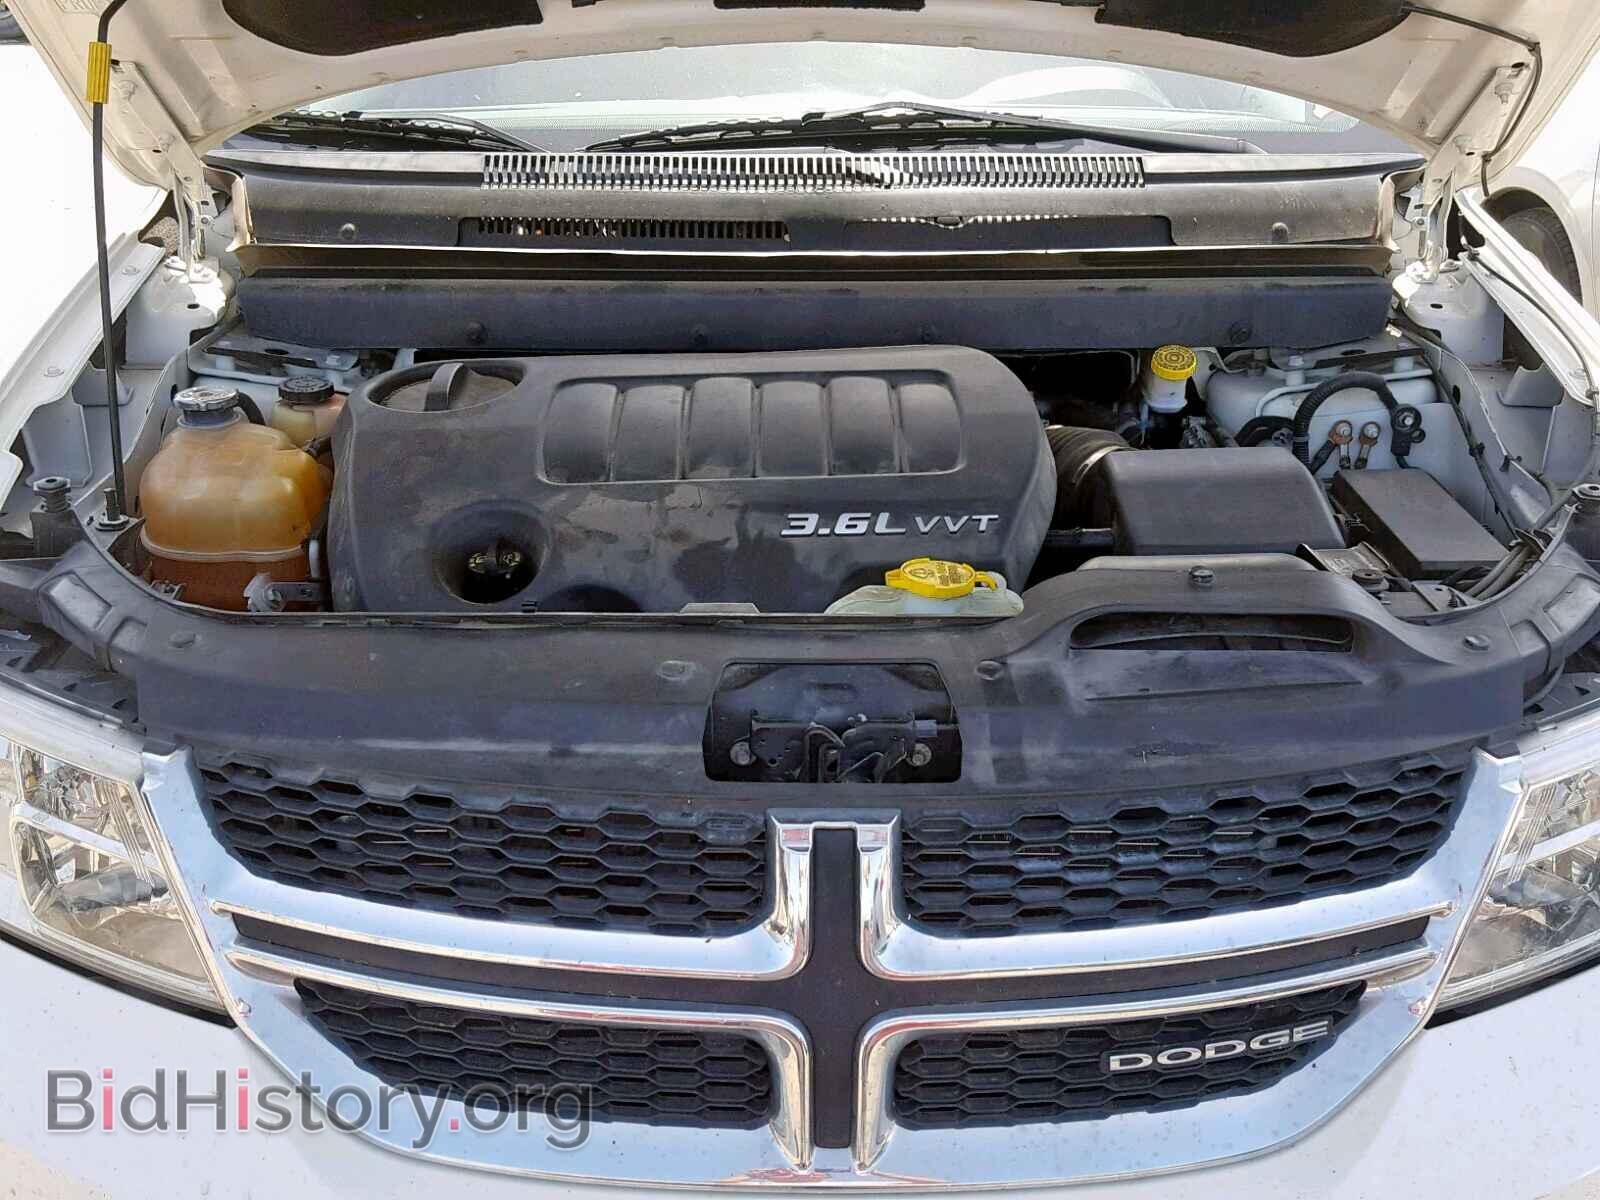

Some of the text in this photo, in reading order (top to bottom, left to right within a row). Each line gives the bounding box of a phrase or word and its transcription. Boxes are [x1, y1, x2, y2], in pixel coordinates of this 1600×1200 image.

[780, 512, 999, 536] 3.6L VVT
[1109, 1020, 1329, 1072] DODGE
